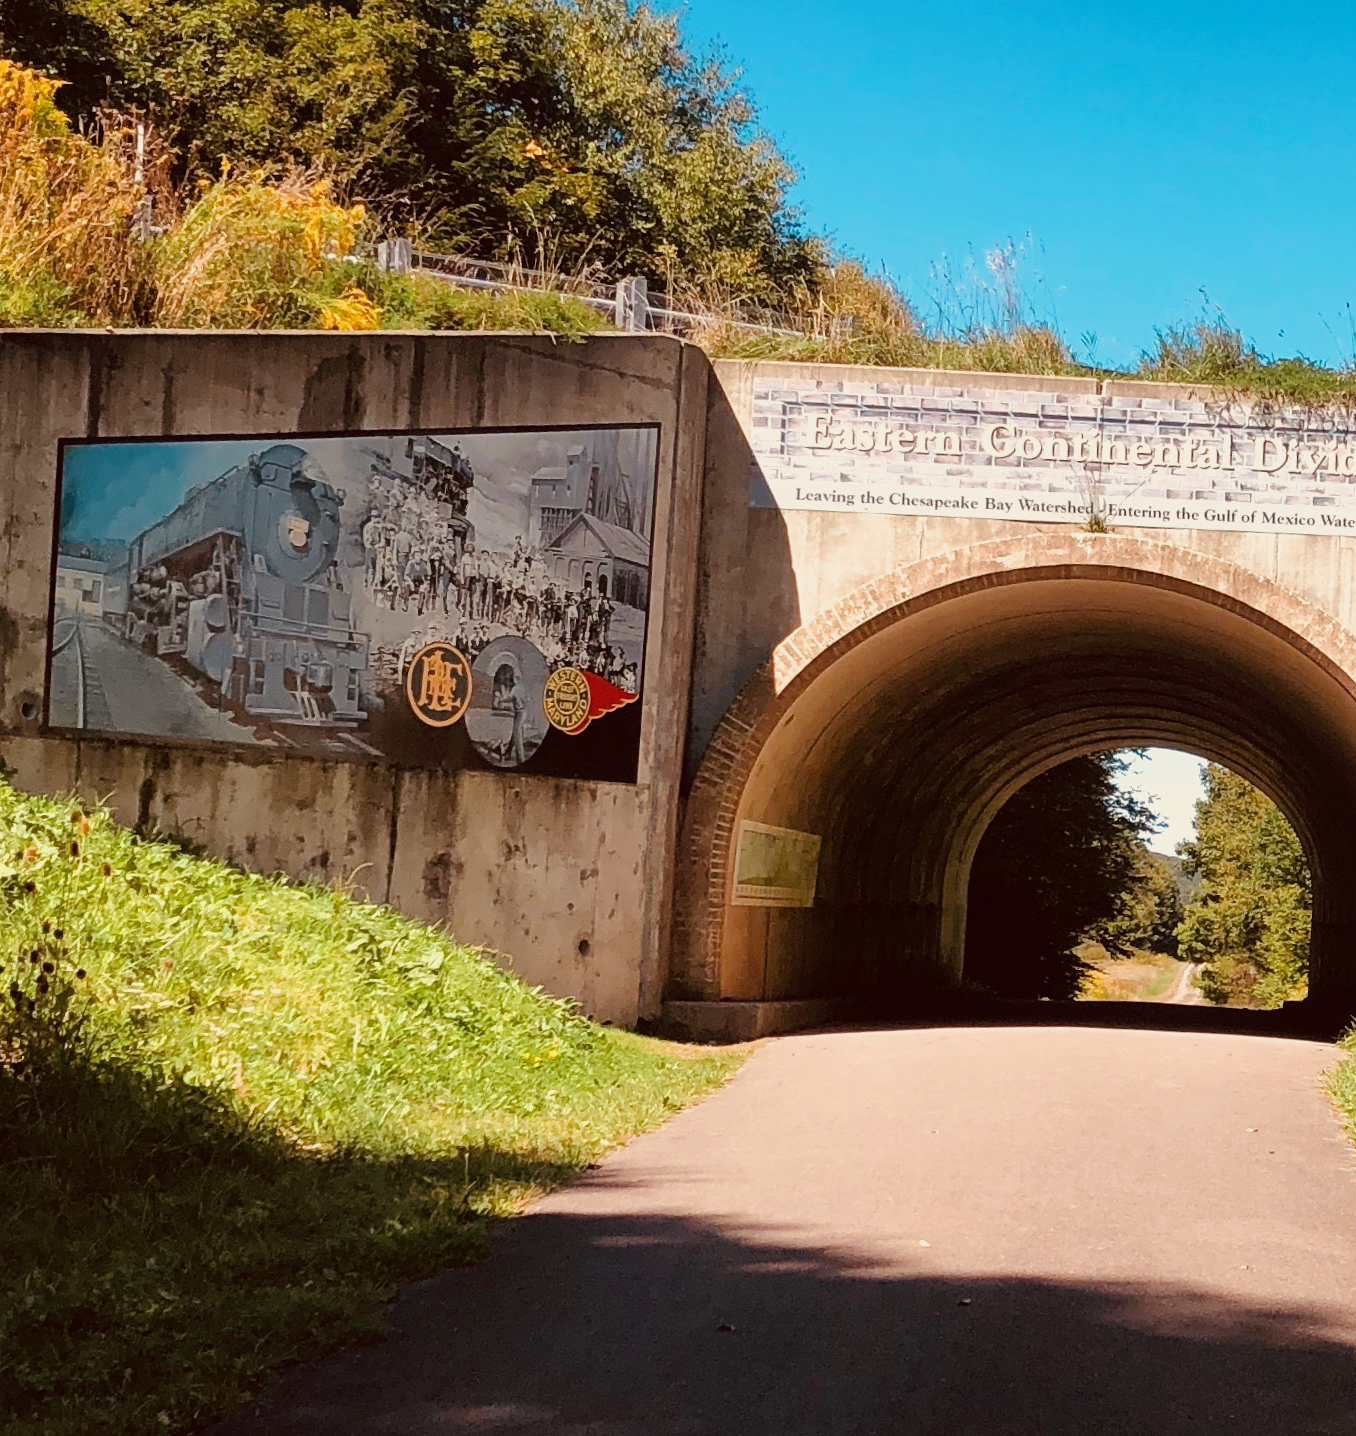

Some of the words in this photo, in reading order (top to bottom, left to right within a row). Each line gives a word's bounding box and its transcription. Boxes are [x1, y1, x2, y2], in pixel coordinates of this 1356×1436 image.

[804, 413, 963, 457] Eastern
[981, 422, 1236, 473] Continental
[796, 488, 855, 506] Leaving
[860, 491, 885, 505] the
[889, 493, 979, 512] Chesapeake
[984, 497, 1014, 514] Bay
[1018, 498, 1094, 515] Watershed
[1108, 502, 1171, 522] Entering
[1177, 506, 1200, 521] the
[1204, 508, 1237, 523] Gulf
[1242, 510, 1258, 524] of
[1262, 511, 1316, 527] Mexico
[547, 669, 588, 694] WESTERN
[545, 697, 588, 727] MARYLAND
